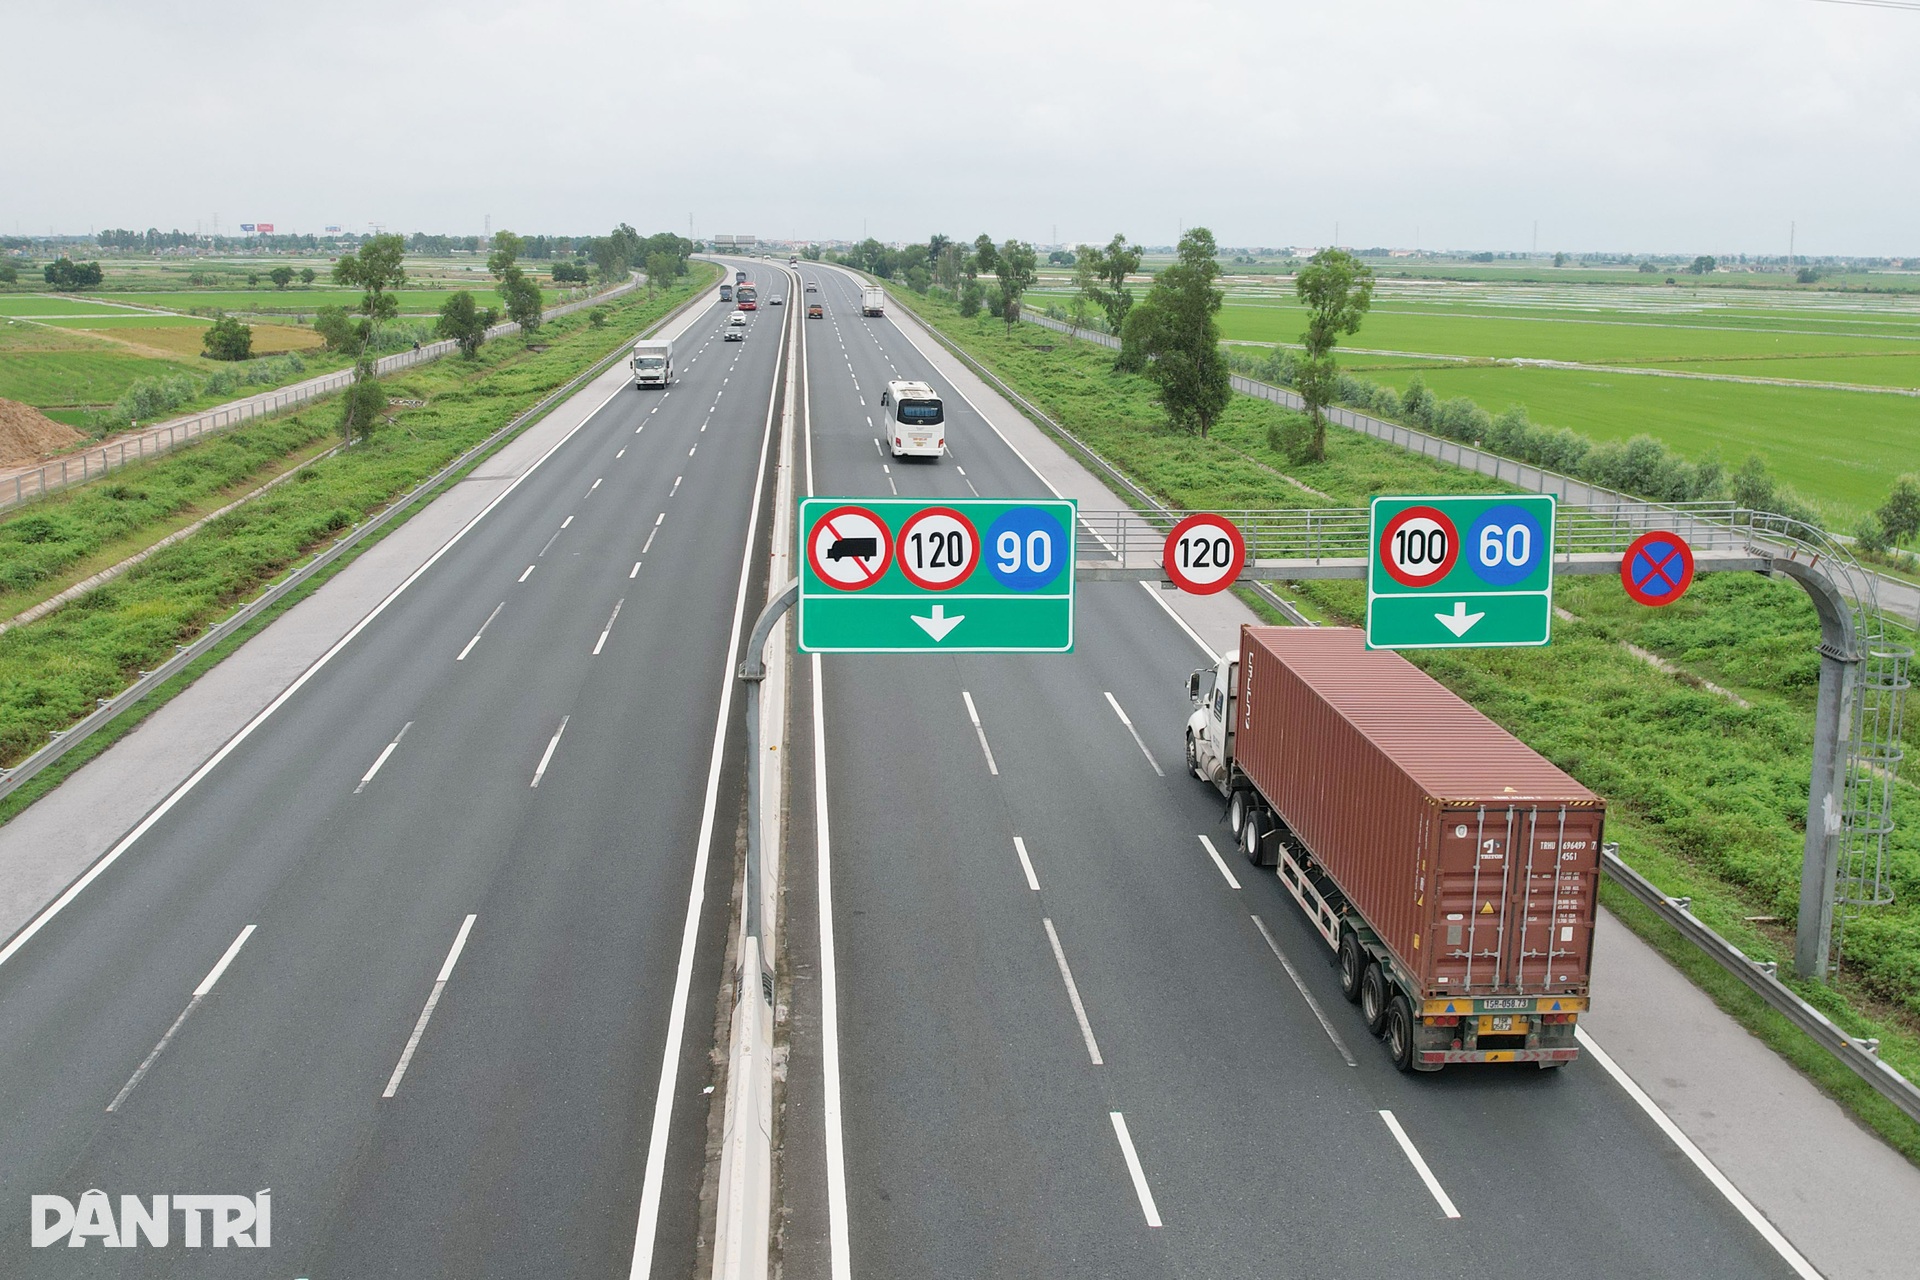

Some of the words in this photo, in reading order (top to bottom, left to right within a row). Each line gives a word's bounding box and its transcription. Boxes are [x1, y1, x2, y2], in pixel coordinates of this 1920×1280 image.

[910, 530, 964, 569] 120
[996, 530, 1052, 574] 90
[1179, 537, 1231, 568] 120
[1395, 528, 1446, 565] 100
[1479, 524, 1531, 567] 60
[1540, 841, 1556, 850] TRHU
[1562, 841, 1587, 850] 696499
[1561, 852, 1577, 861] 45G1
